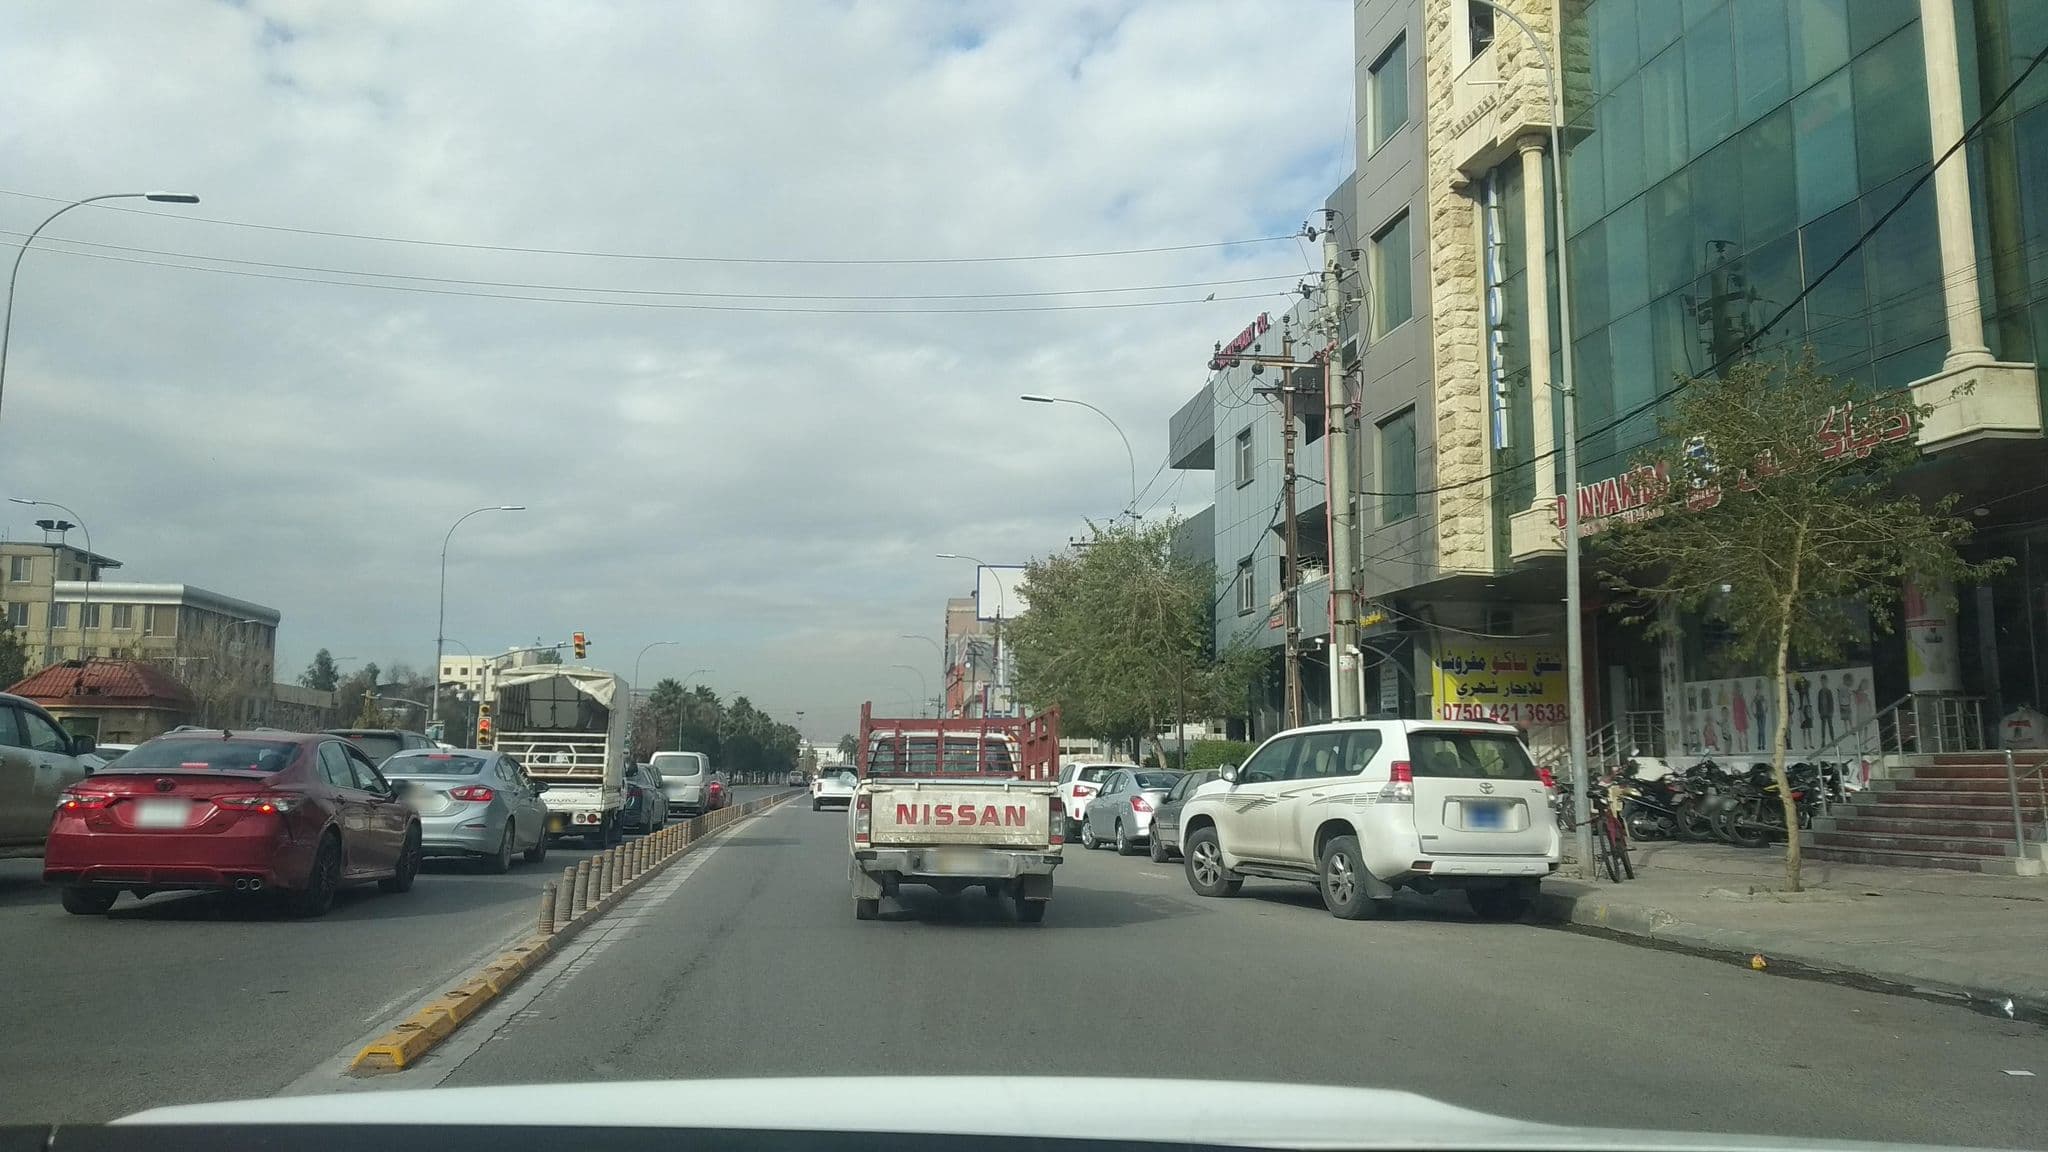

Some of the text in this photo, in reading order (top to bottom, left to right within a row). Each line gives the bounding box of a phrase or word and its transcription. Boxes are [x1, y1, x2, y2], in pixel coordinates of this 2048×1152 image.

[1444, 703, 1567, 721] 0750 421 3638
[895, 803, 1026, 827] NISSAN
